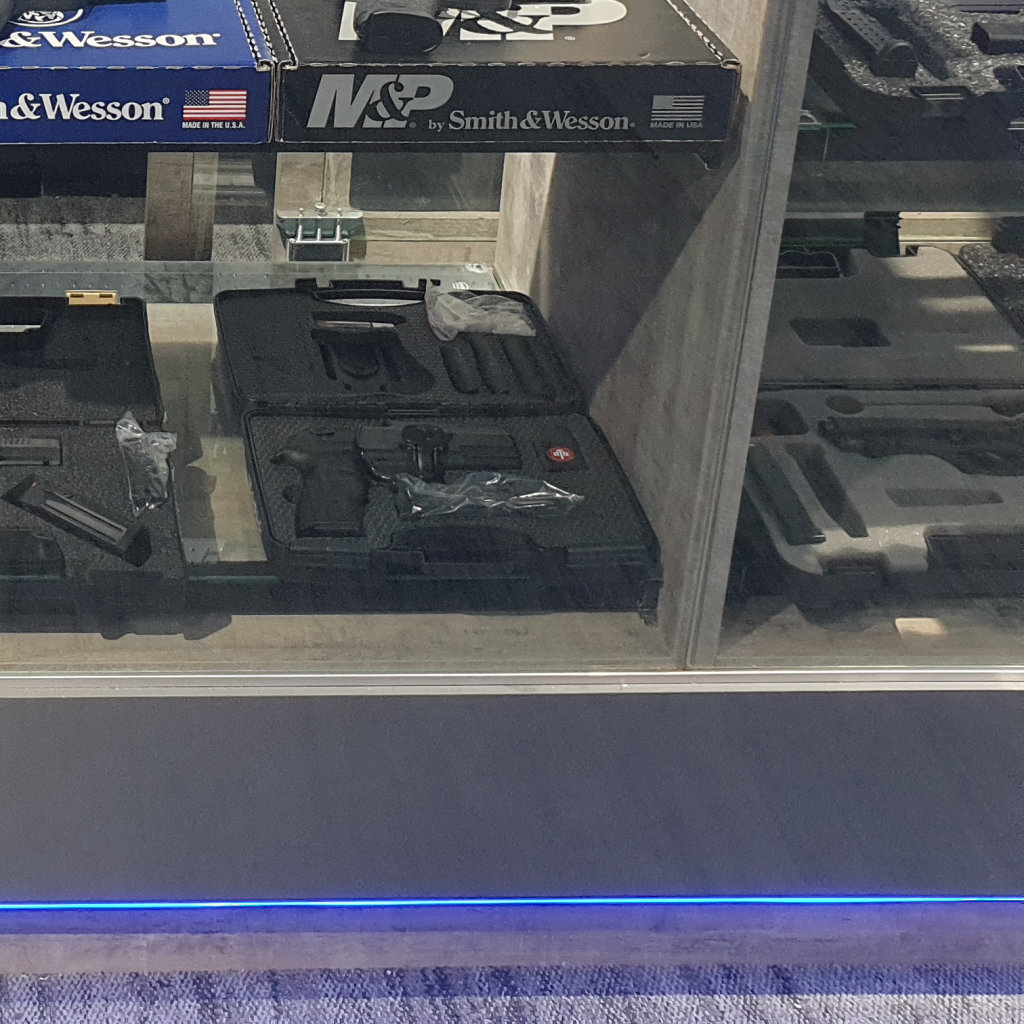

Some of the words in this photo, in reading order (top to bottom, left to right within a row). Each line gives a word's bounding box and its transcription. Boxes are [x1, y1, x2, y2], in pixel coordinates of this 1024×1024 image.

[306, 74, 454, 128] M&P
[182, 121, 201, 129] MADE
[202, 121, 210, 129] IN
[211, 121, 224, 129] THE
[428, 119, 445, 132] by
[650, 121, 674, 129] MADE
[676, 121, 685, 129] IN
[686, 121, 704, 129] USA
